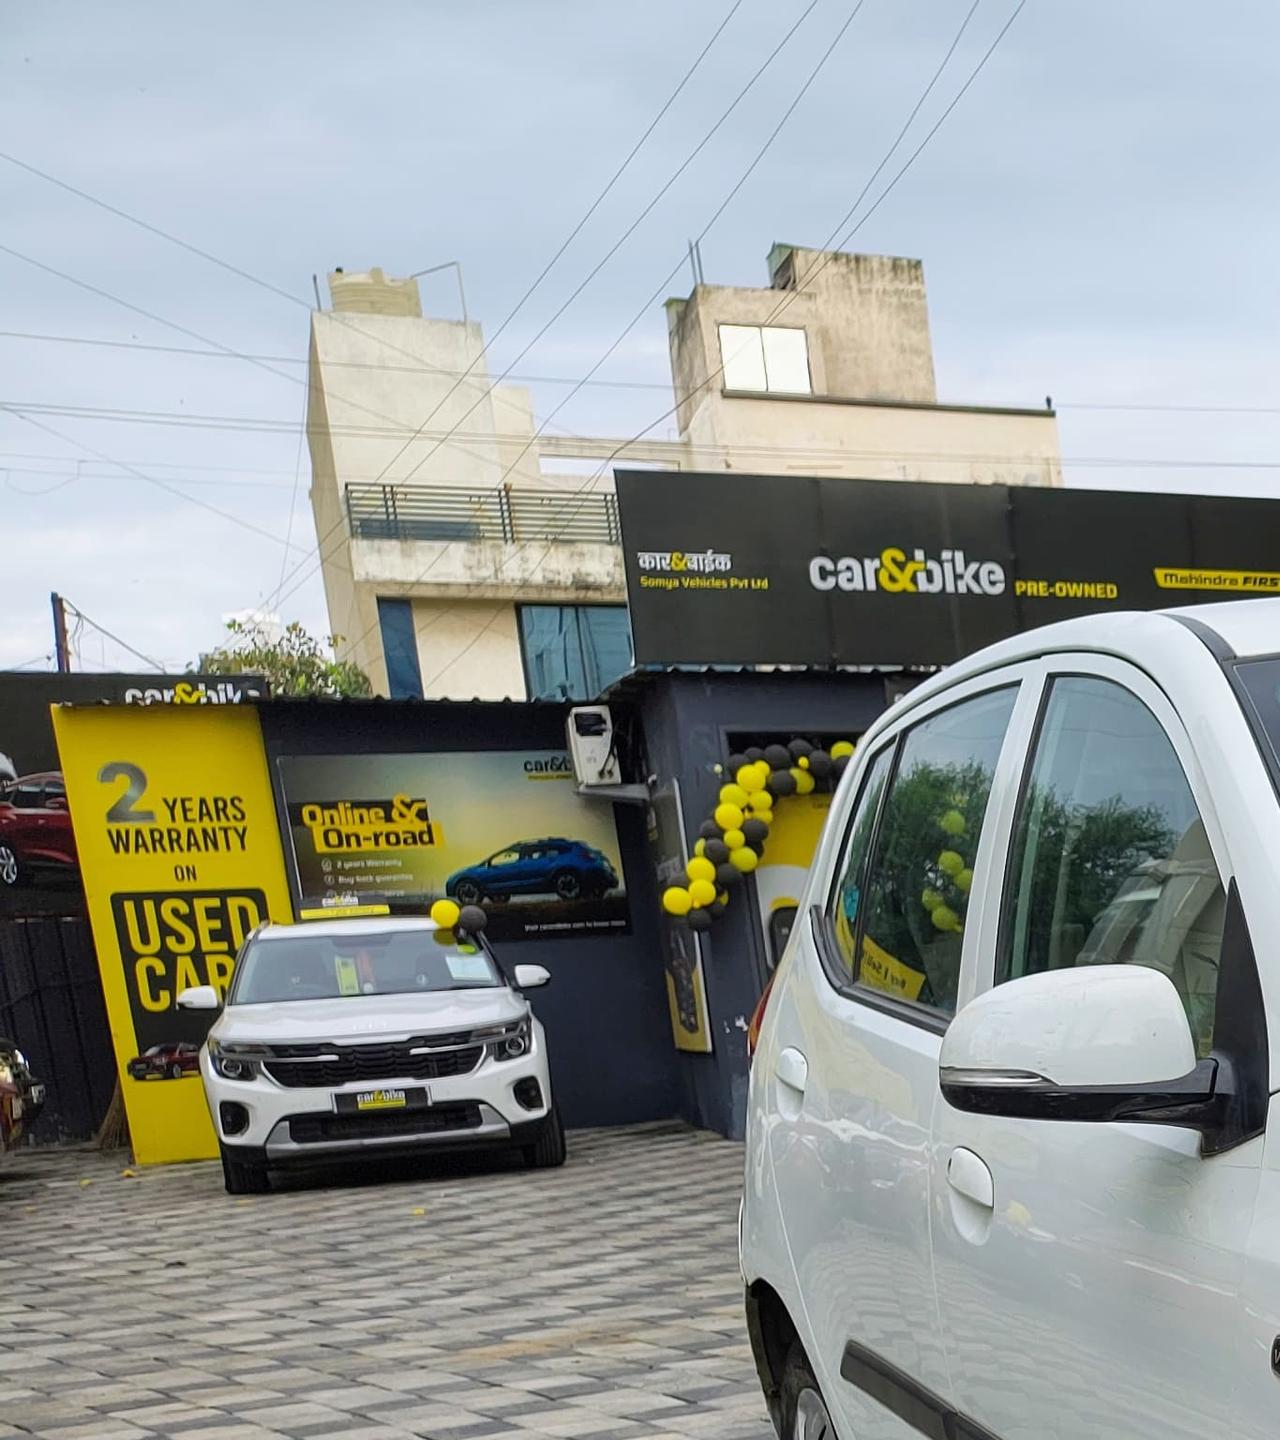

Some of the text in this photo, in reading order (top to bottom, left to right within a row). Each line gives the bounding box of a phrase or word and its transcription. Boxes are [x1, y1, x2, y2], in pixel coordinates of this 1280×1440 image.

[682, 577, 728, 589] Vehicles
[730, 577, 748, 589] Pvt
[751, 578, 768, 589] Ltd
[809, 547, 1117, 599] car&bike PRE-OWNED
[1163, 572, 1239, 587] Mahindra
[97, 761, 246, 823] 2 YEARS
[302, 793, 428, 828] Online &
[107, 827, 247, 853] WARRANTY
[323, 827, 434, 849] On-road
[174, 865, 197, 881] ON
[123, 897, 259, 954] USED
